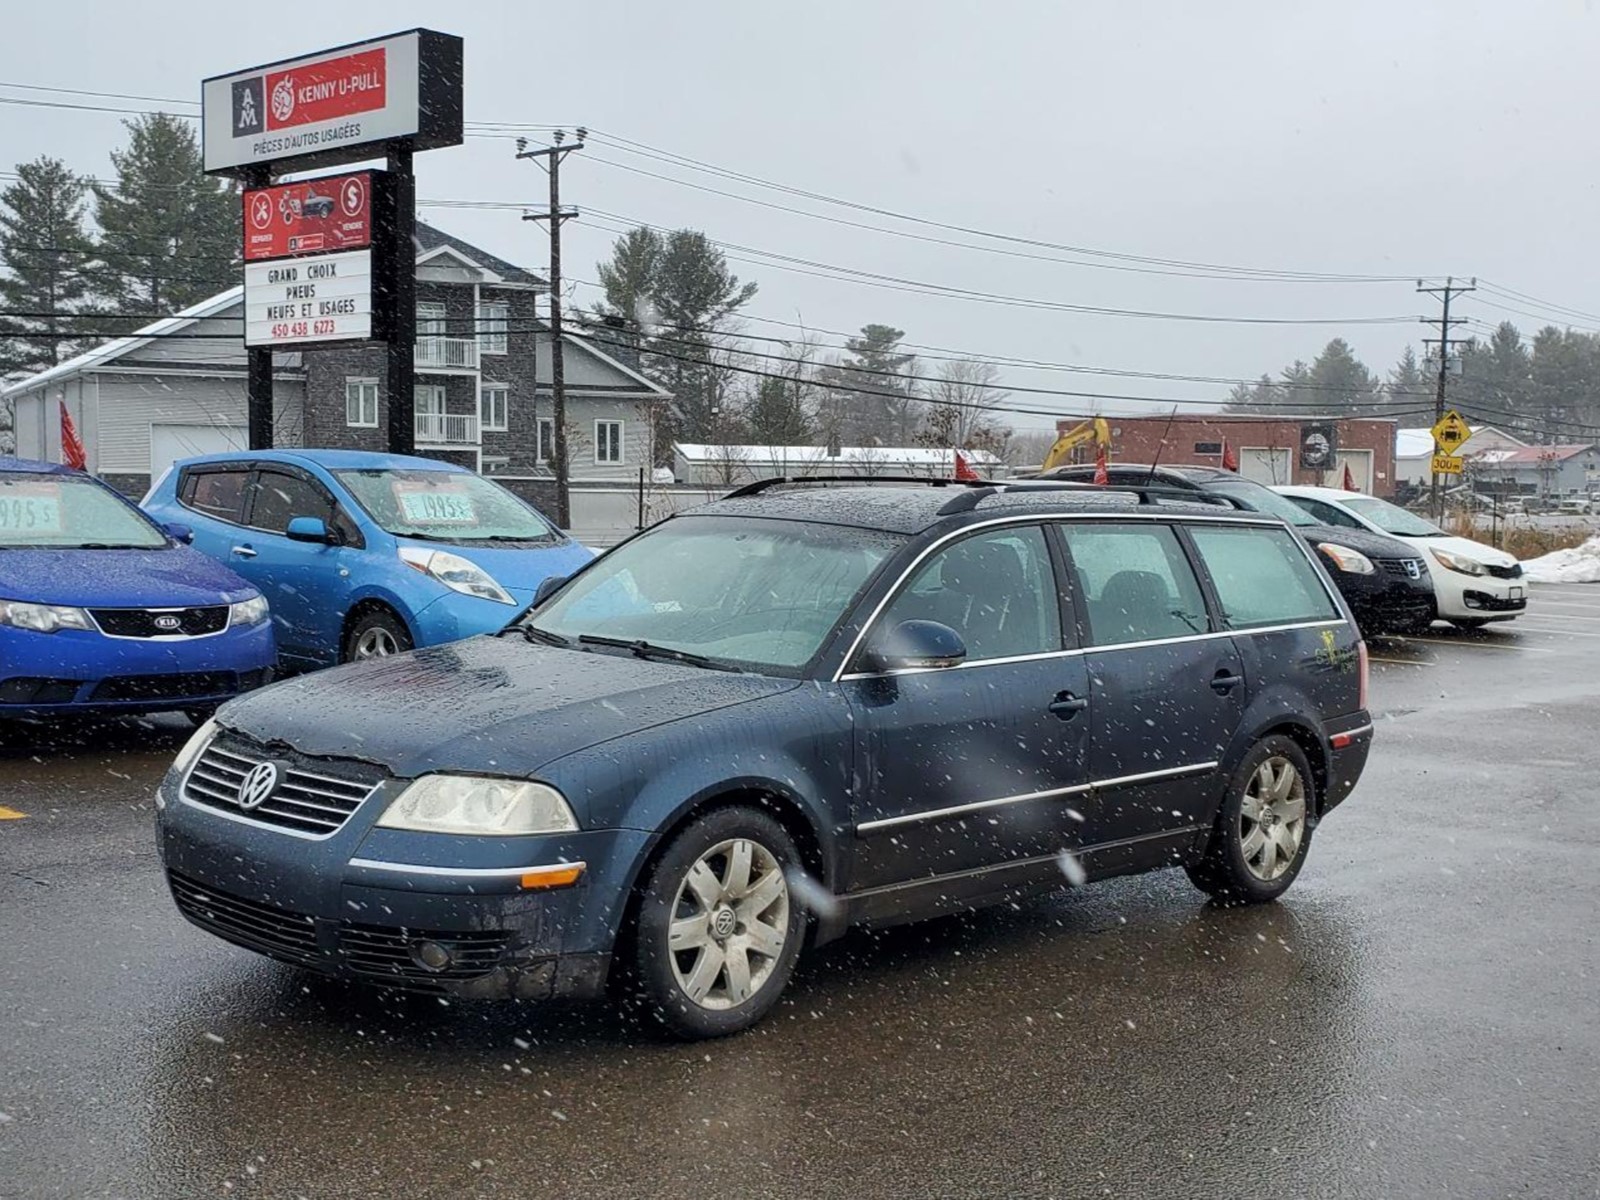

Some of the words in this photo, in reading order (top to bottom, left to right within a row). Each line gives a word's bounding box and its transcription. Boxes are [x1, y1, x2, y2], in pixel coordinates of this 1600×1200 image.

[298, 80, 336, 104] KENNY
[339, 71, 381, 95] U-PULL
[253, 138, 283, 156] PIÈCES
[284, 131, 319, 150] D'AUTOS
[320, 121, 361, 143] USAGÉES
[268, 268, 298, 283] GRAND
[307, 263, 337, 279] CHOIX
[286, 284, 316, 300] PNEUS
[267, 304, 296, 320] NEUFS
[301, 303, 312, 317] ET
[319, 299, 355, 315] USAGES
[271, 324, 289, 337] 450
[291, 322, 308, 335] 438
[313, 319, 335, 333] 6273
[1433, 460, 1452, 469] 300
[160, 618, 177, 626] KIA
